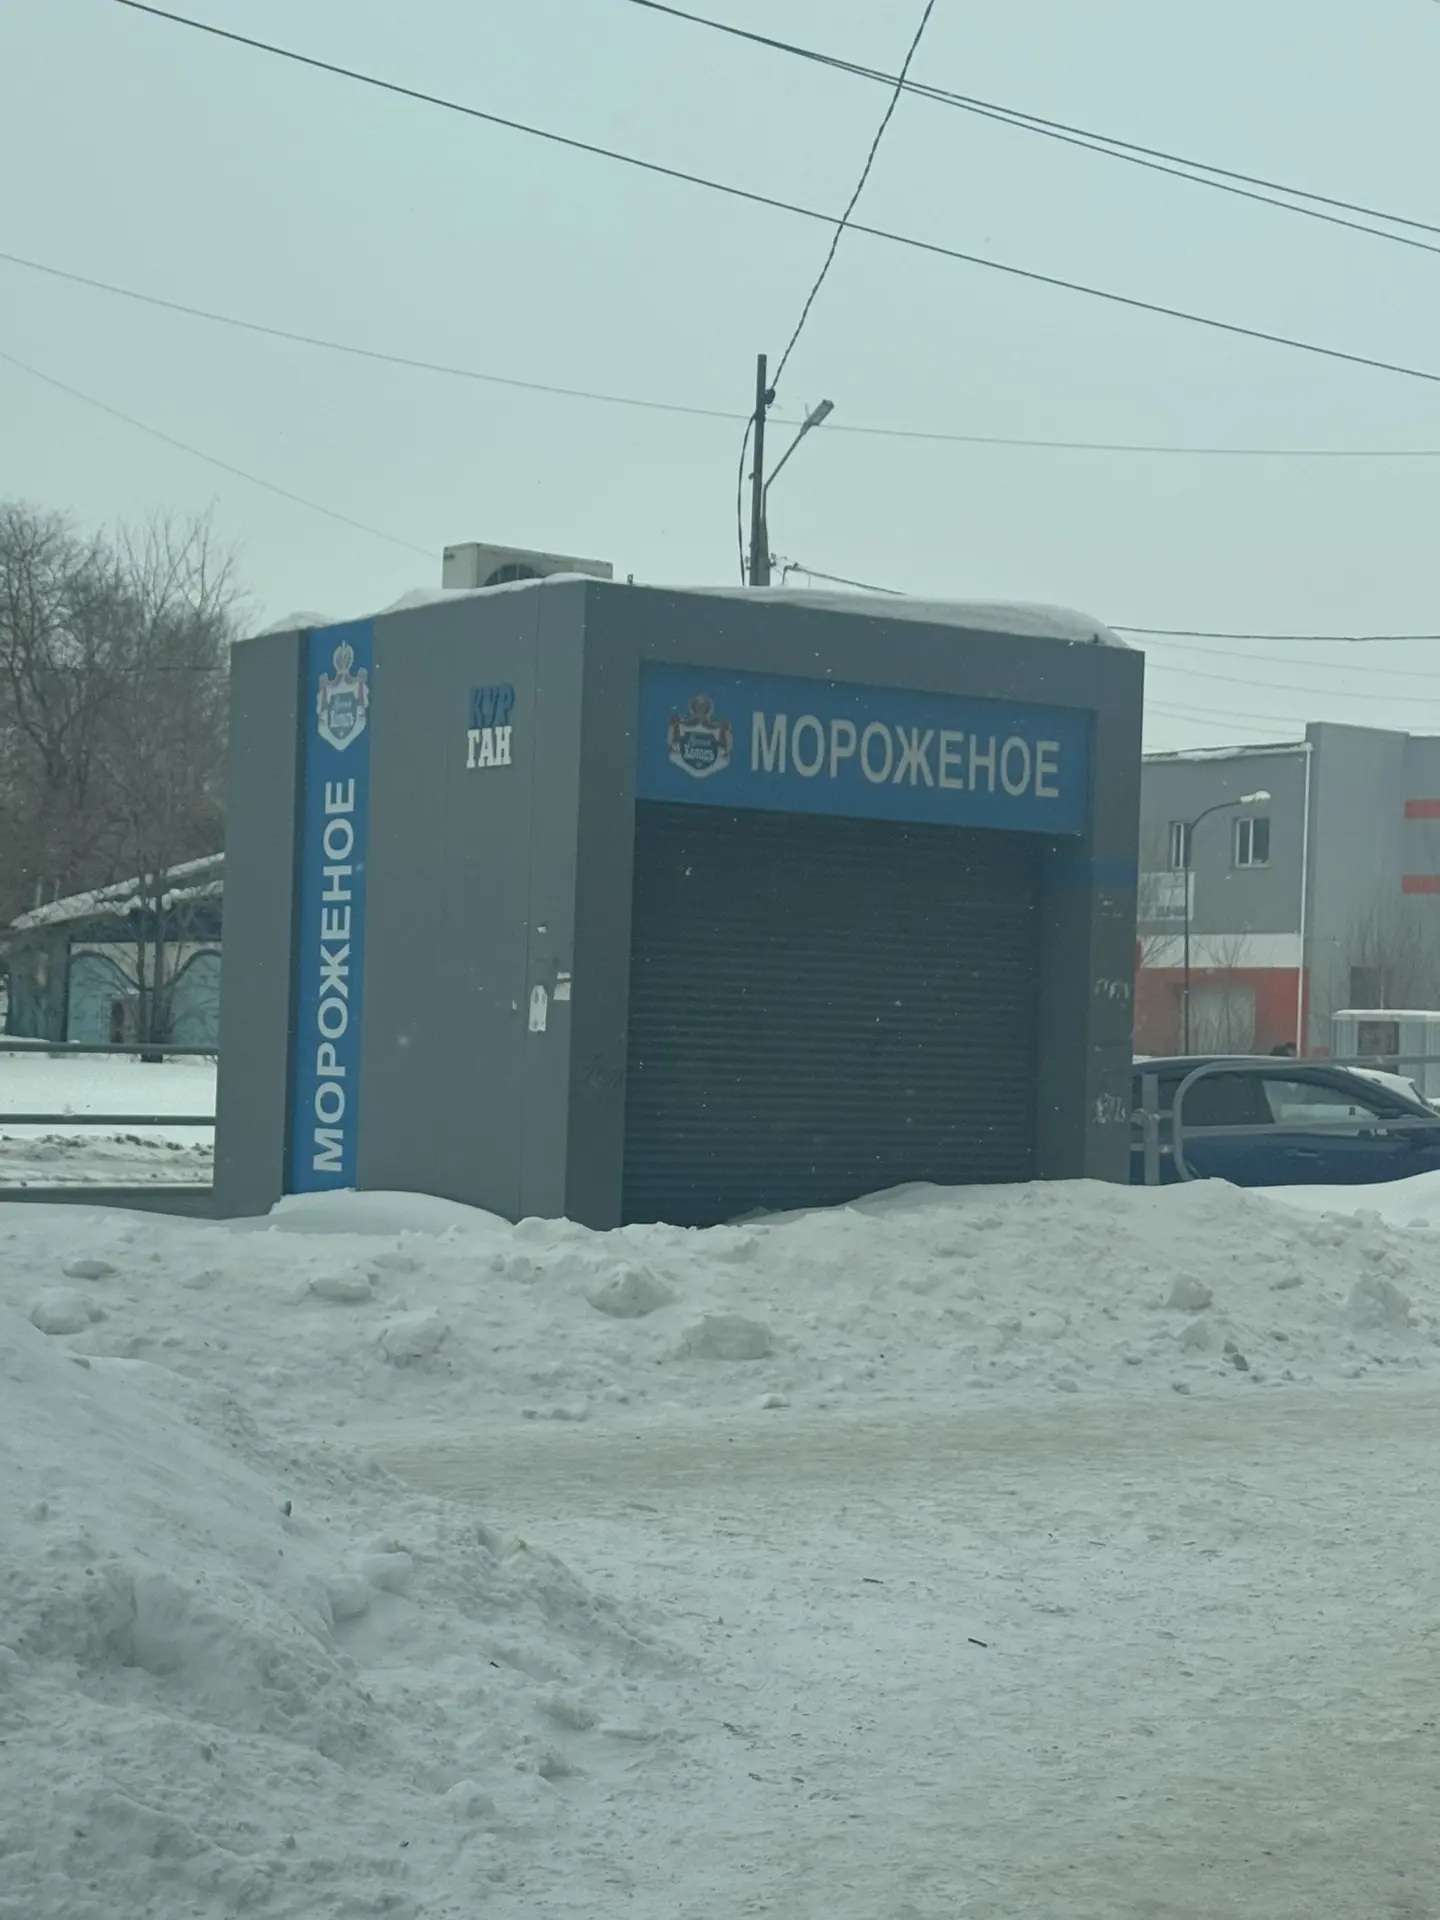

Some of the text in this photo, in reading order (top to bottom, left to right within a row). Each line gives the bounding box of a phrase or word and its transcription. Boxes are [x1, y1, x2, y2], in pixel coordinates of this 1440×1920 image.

[466, 725, 512, 768] ГАН
[751, 711, 1061, 799] МОРОЖЕНОЕ
[313, 777, 355, 1172] МОРОЖЕНОЕ
